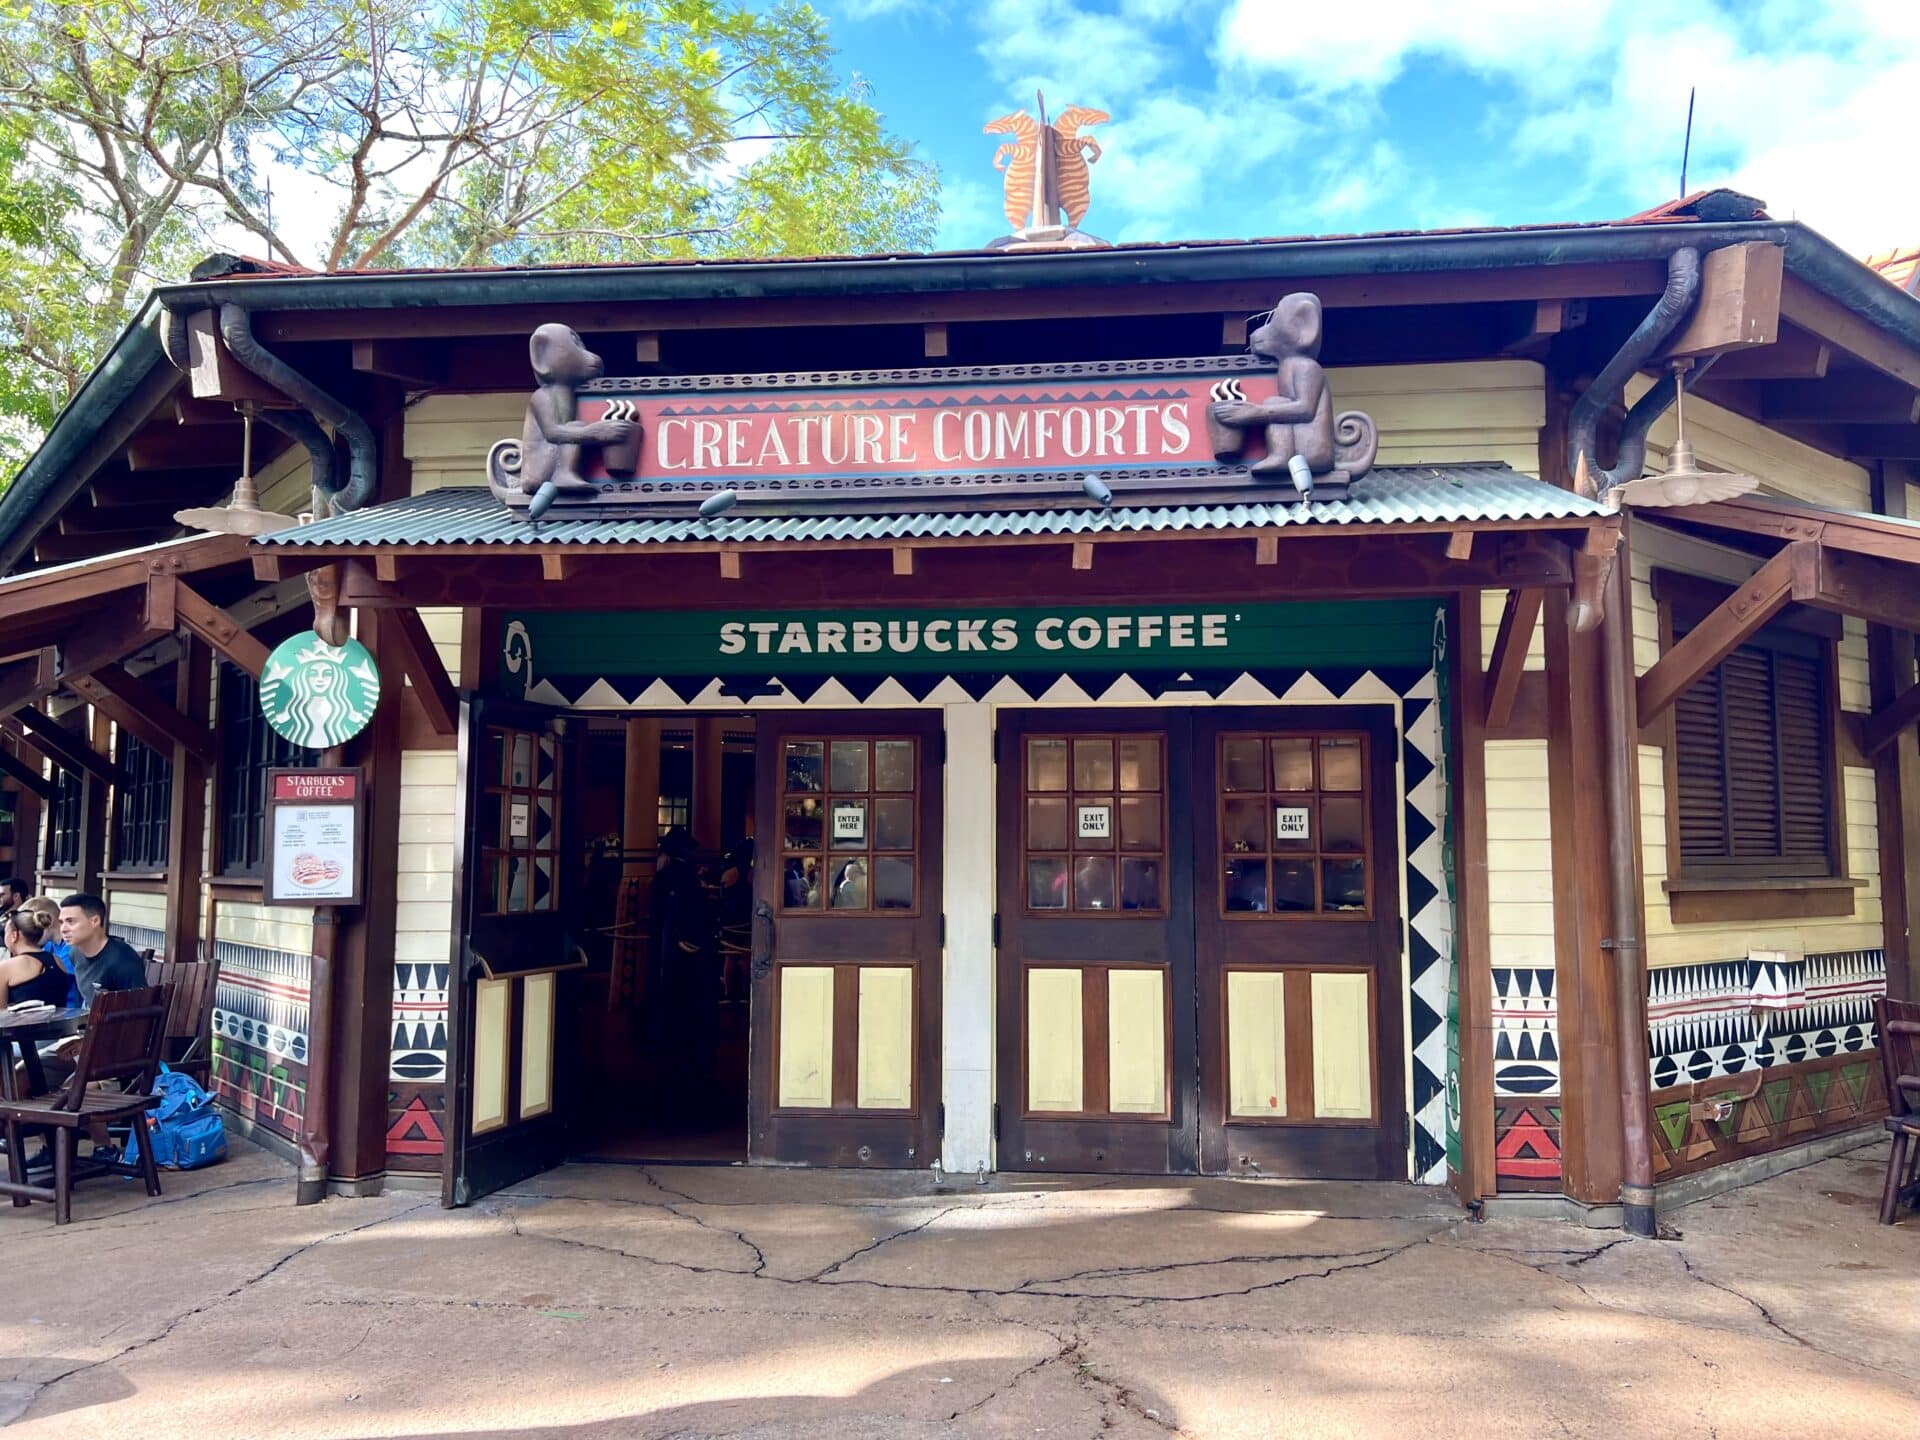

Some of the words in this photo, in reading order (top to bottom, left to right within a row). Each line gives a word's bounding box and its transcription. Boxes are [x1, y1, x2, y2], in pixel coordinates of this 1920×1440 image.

[657, 413, 917, 470] CREATURE
[932, 402, 1191, 463] COMFORTS
[718, 618, 1019, 655] STARBUCKS
[1034, 613, 1229, 650] COFFEE
[287, 775, 345, 786] STARBUCKS
[296, 786, 334, 797] COFFEE
[837, 815, 860, 823] ENTER
[1084, 814, 1104, 822] EXIT
[1282, 814, 1304, 823] EXIT
[840, 822, 858, 830] HERE
[1082, 822, 1105, 831] ONLY
[1280, 823, 1305, 832] ONLY
